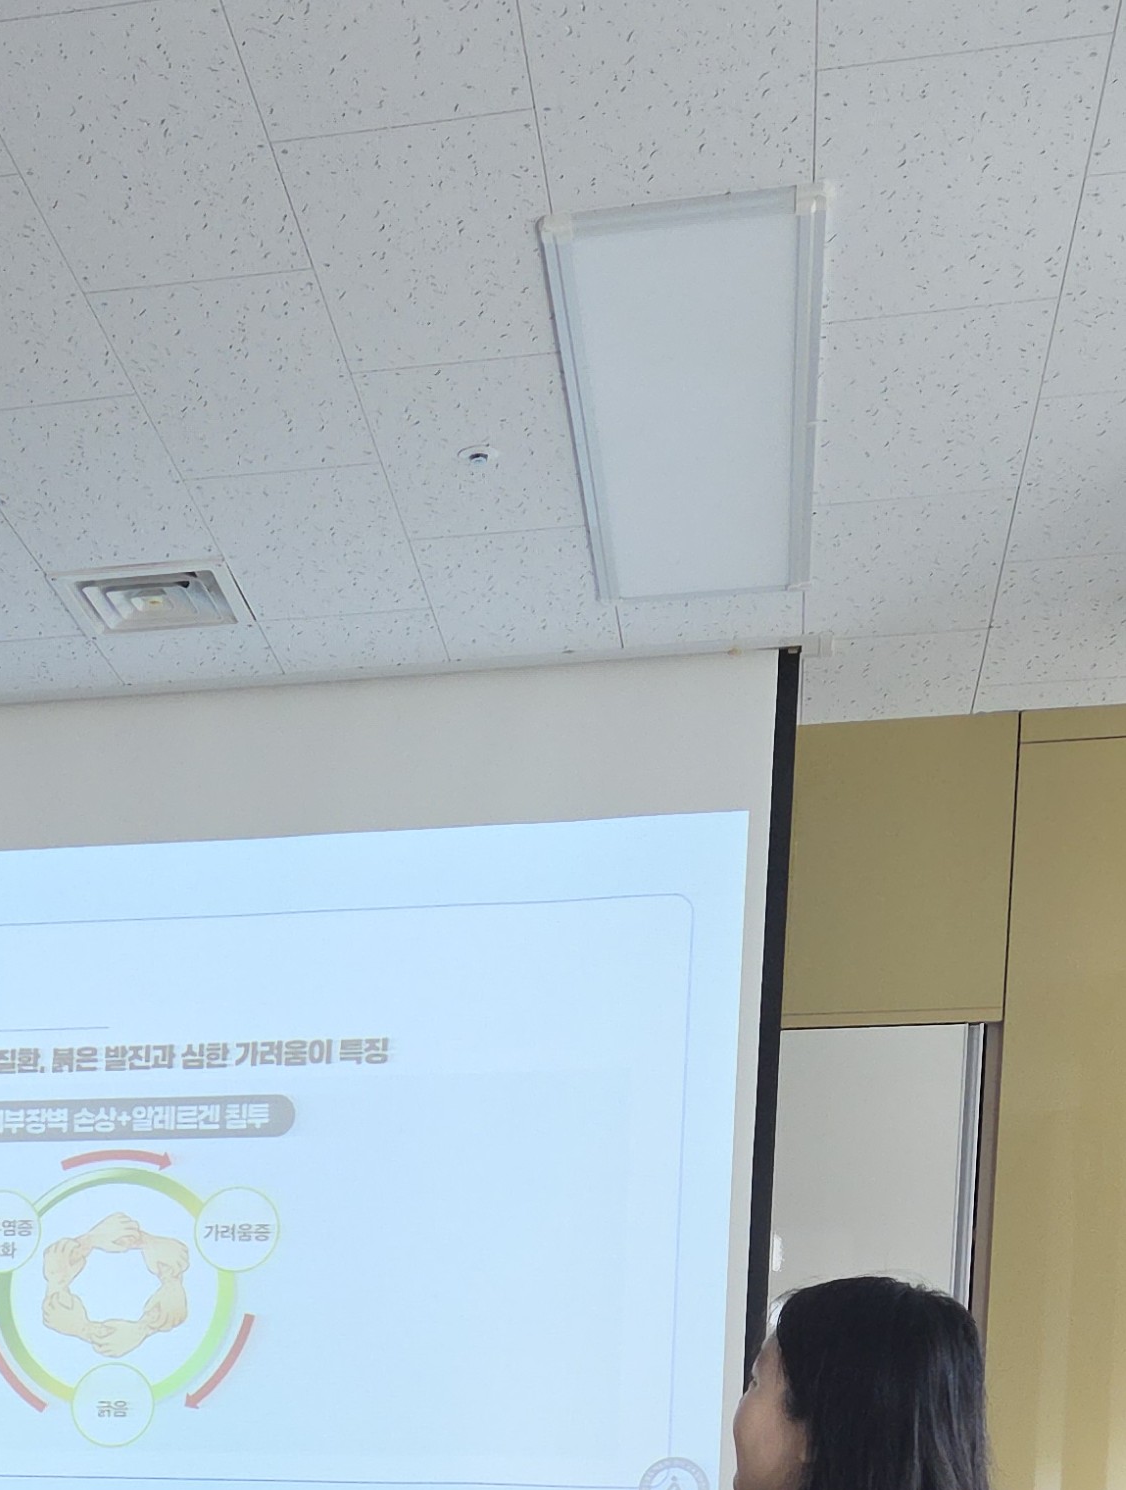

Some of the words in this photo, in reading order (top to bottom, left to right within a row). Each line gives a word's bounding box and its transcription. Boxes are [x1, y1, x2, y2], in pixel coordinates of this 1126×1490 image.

[52, 1046, 98, 1072] 붉은
[104, 1043, 175, 1071] 발진과
[181, 1041, 230, 1069] 심한
[235, 1038, 332, 1067] 가려움이
[339, 1037, 389, 1065] 특징
[225, 1103, 270, 1130] 침투
[203, 1223, 272, 1242] 가려움증
[96, 1400, 128, 1418] 긁음
